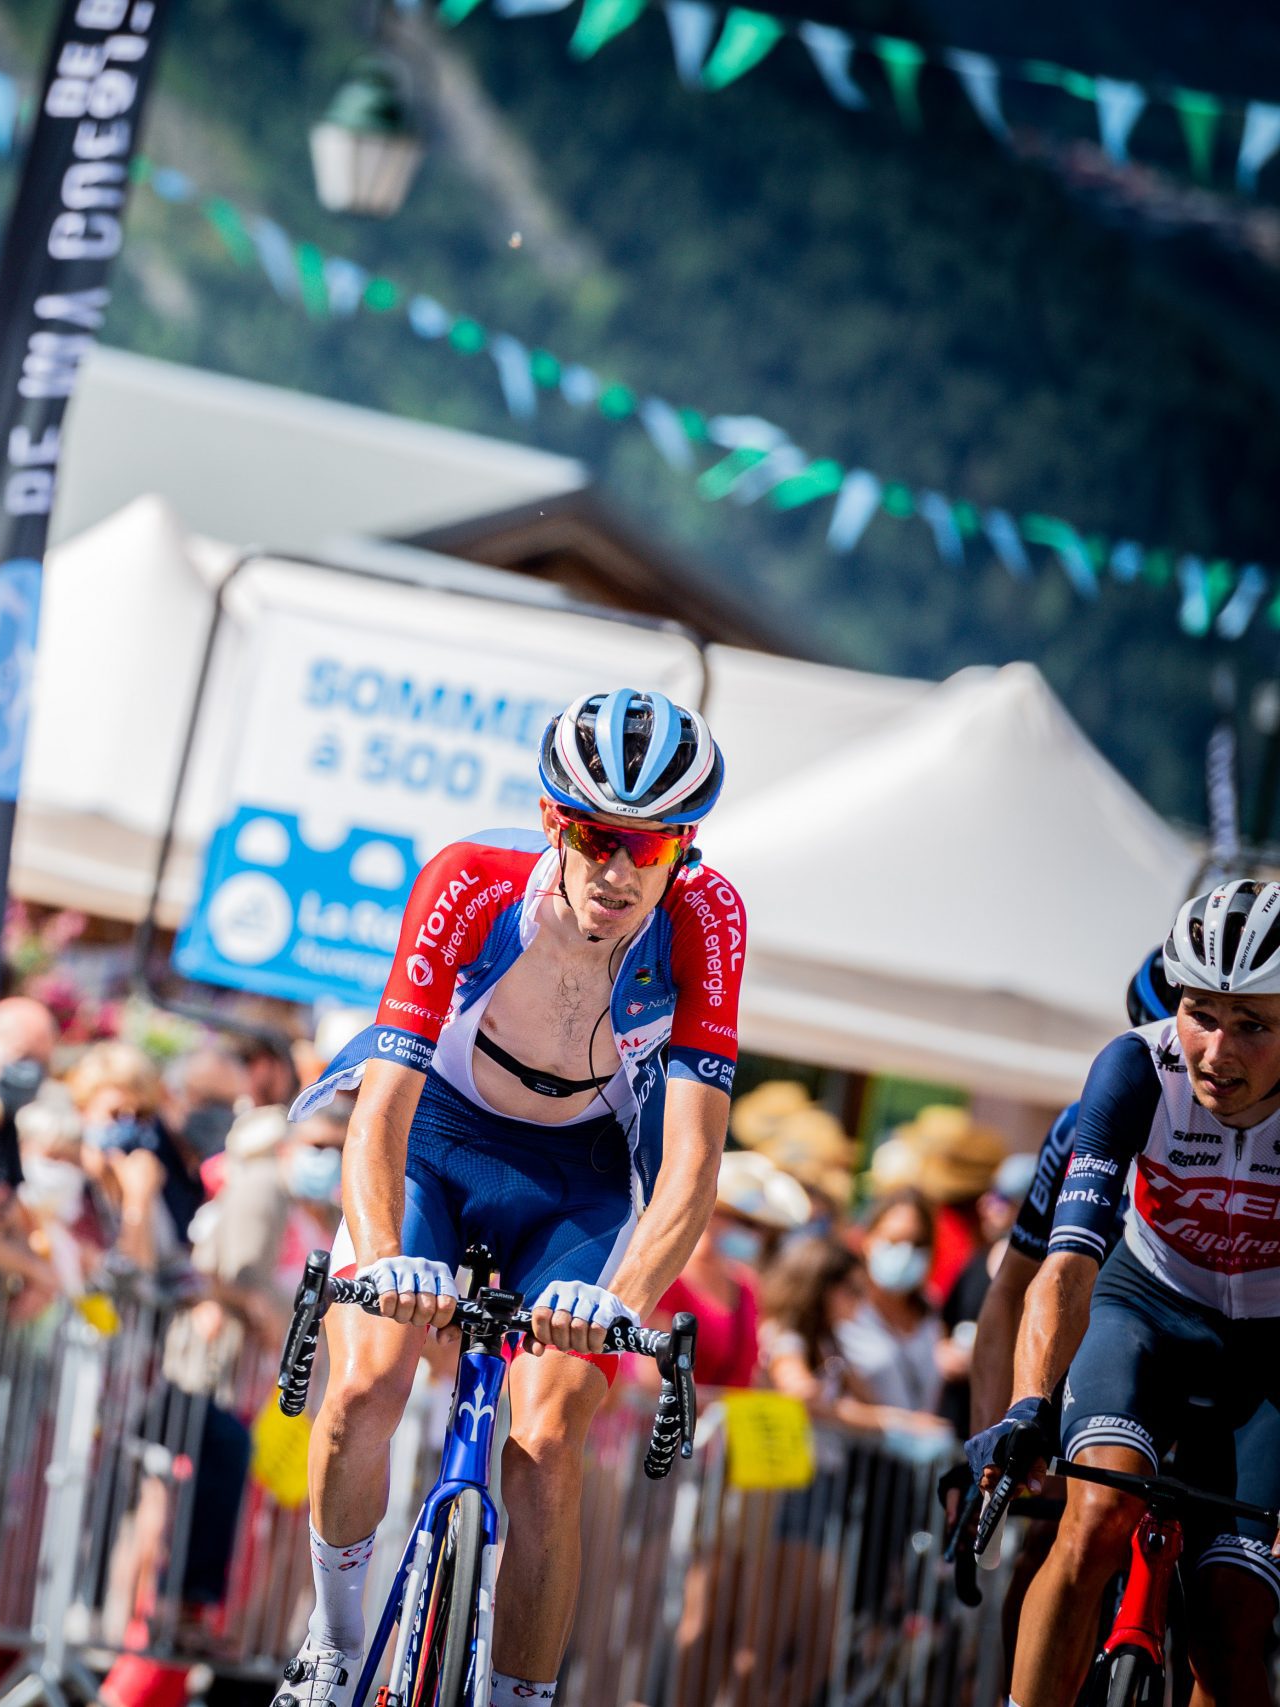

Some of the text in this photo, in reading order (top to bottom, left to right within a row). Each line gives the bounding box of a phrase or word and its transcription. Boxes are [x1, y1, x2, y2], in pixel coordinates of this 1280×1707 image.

[304, 656, 558, 749] SOMME
[359, 732, 483, 800] 500
[415, 869, 480, 949] TOTAL
[440, 879, 513, 966] direct energie
[706, 873, 742, 972] TOTAL
[1261, 892, 1280, 914] TREK
[684, 889, 727, 1007] direct energie
[1209, 929, 1217, 967] TREK
[1239, 930, 1257, 970] BONTRAGER
[1155, 1061, 1188, 1073] TRE
[1168, 1149, 1222, 1167] Santini
[1145, 1167, 1280, 1220] TRE
[1152, 1217, 1280, 1253] Segafre
[489, 1291, 515, 1301] GARMIN
[1087, 1415, 1154, 1443] Santini
[978, 1474, 1013, 1538] SRAM
